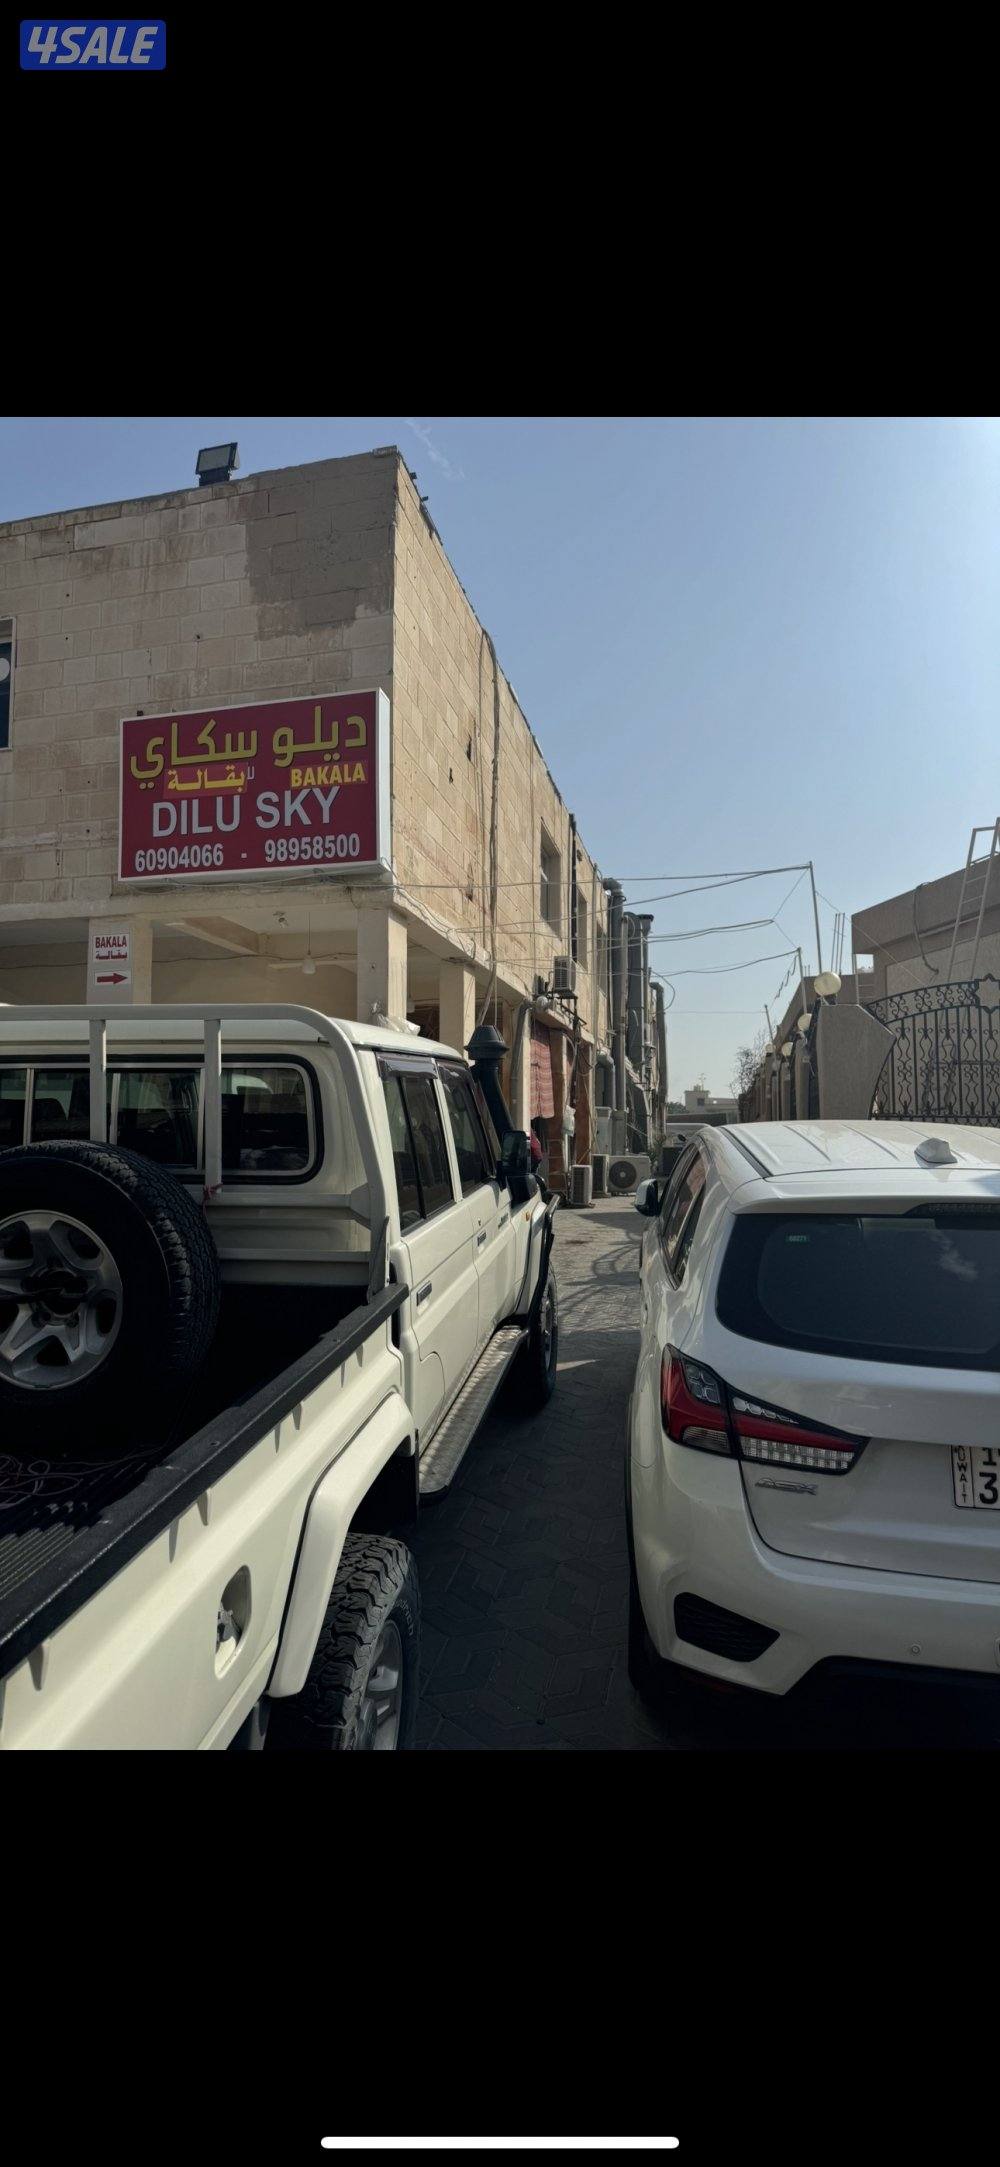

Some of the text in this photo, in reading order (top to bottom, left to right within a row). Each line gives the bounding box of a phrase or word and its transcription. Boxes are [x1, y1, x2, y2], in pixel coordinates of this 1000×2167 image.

[130, 705, 367, 790] ديلو سكاي
[167, 764, 247, 793] بقالة
[290, 763, 367, 788] BAKALA
[152, 785, 341, 838] DILU SKY
[134, 843, 224, 872] 60904066
[264, 832, 361, 863] 98958500
[95, 936, 127, 949] BAKALA
